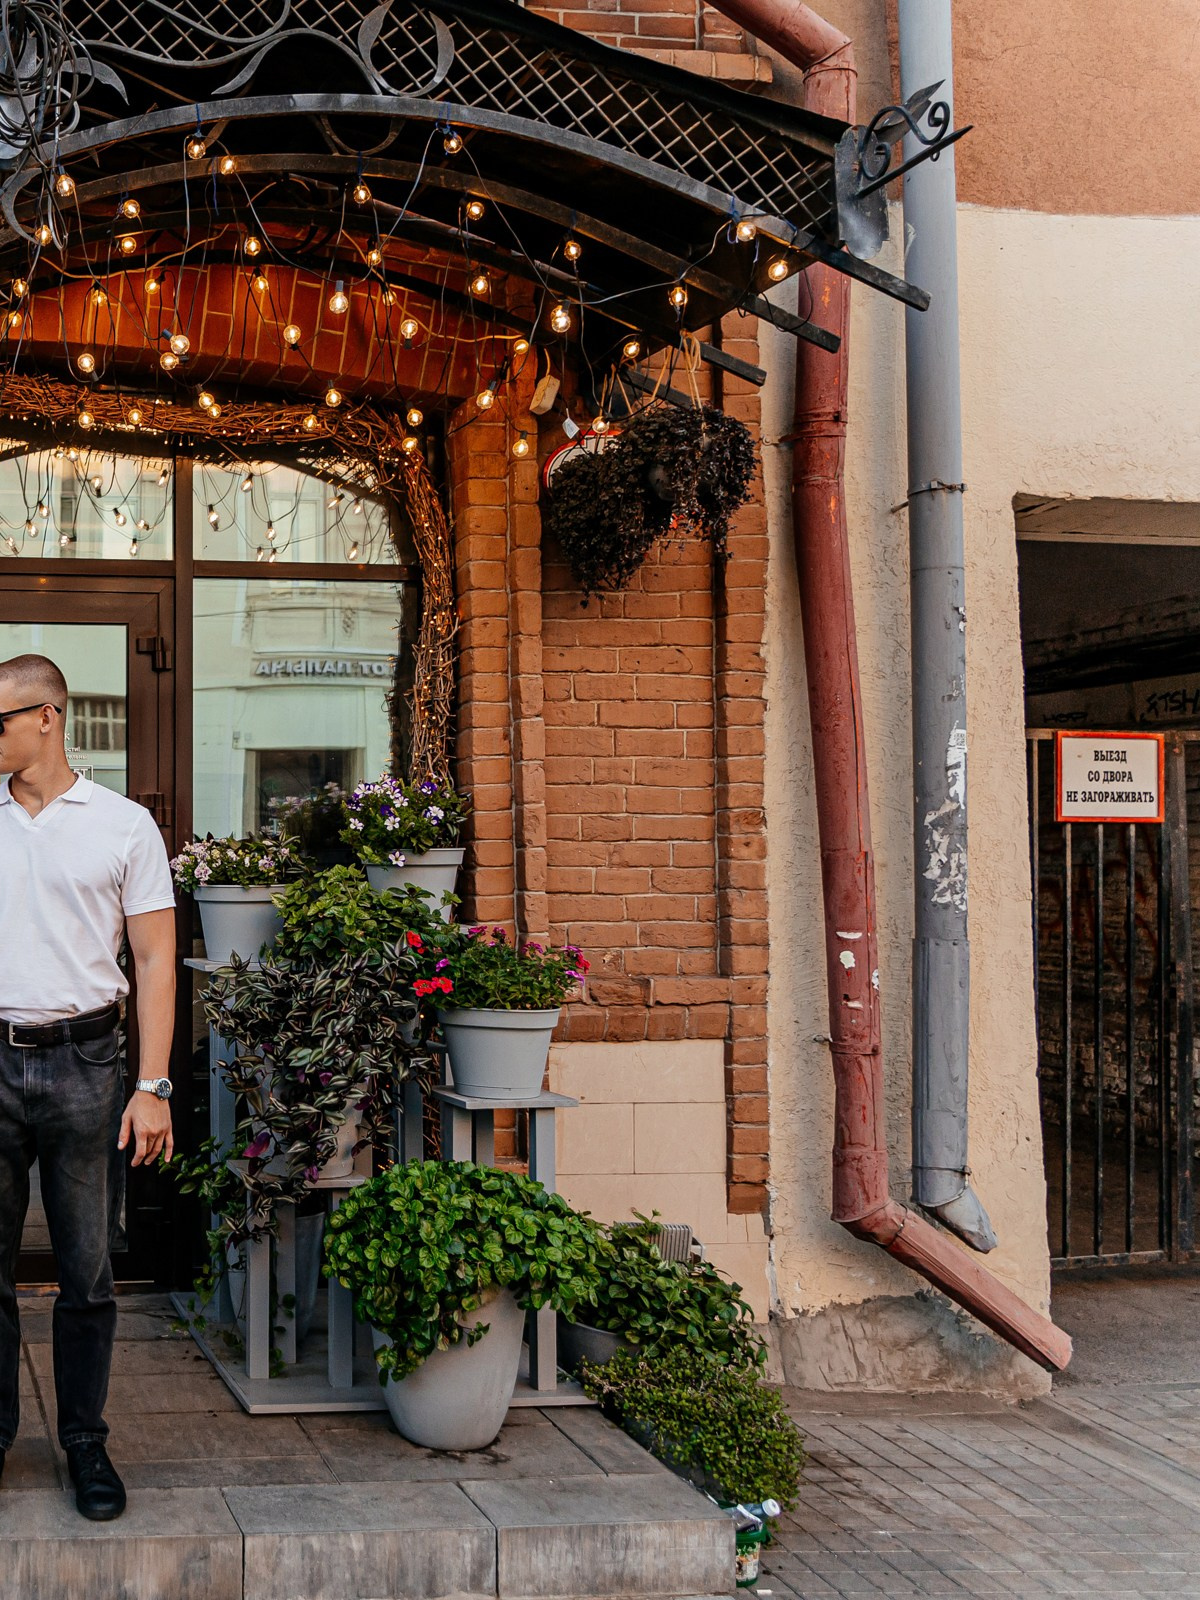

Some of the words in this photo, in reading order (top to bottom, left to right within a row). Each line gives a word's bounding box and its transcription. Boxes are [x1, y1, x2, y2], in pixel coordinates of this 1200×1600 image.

[1094, 751, 1127, 763] ВЫЕЗД
[1087, 770, 1100, 782] СО
[1103, 771, 1133, 783] ДВОРА
[1066, 791, 1078, 803] НЕ
[1080, 791, 1155, 803] ЗАГОРАЖИВАТЬ
